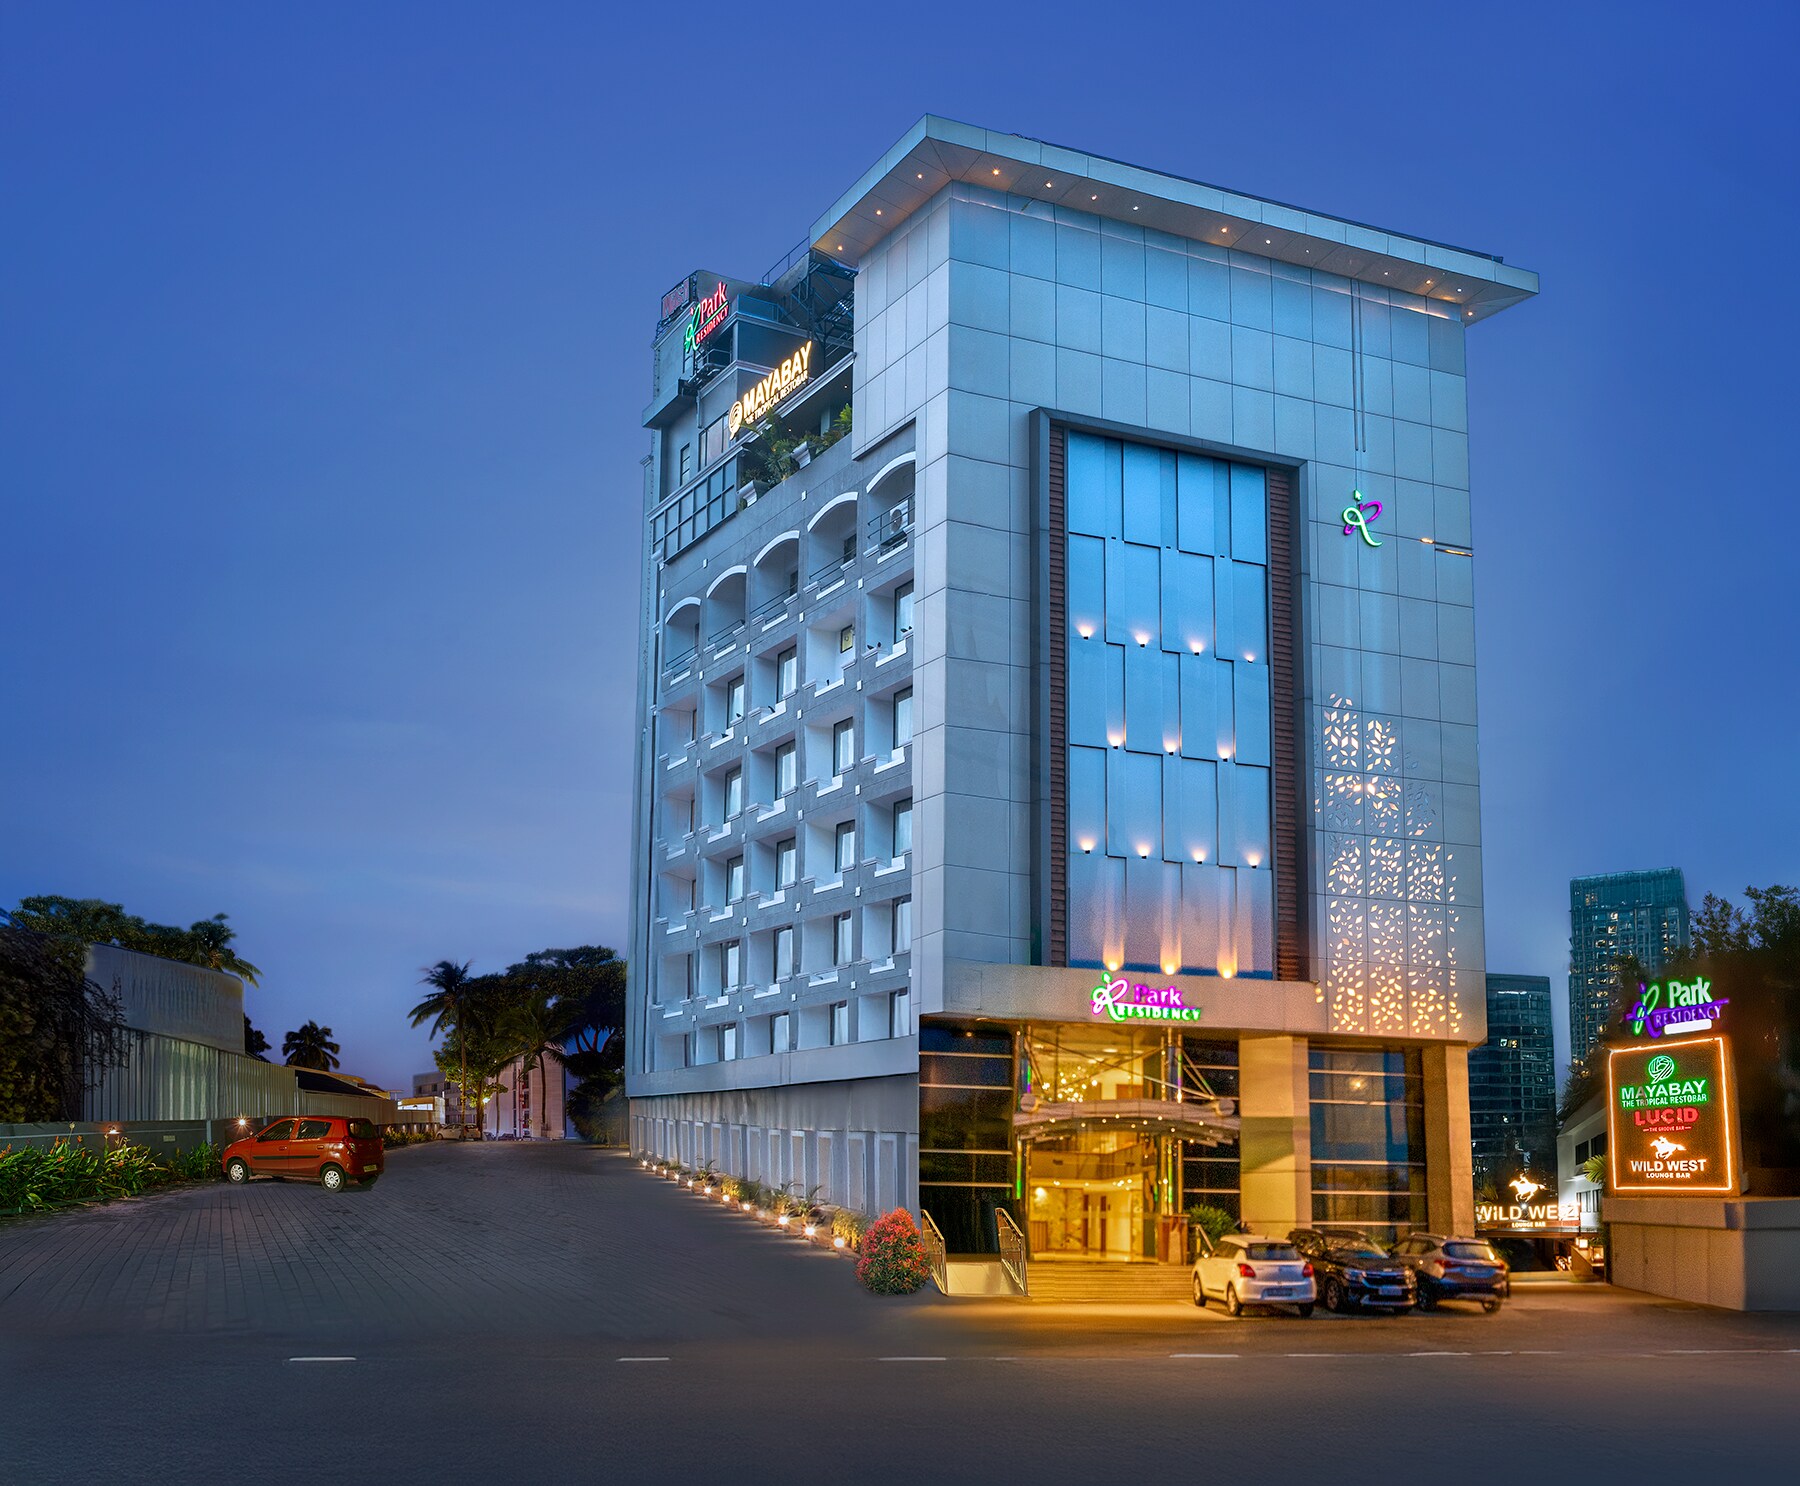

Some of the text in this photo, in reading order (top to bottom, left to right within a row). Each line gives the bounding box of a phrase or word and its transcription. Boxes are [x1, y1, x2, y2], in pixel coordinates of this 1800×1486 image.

[701, 281, 728, 325] Park
[696, 305, 729, 345] RESIDENCY
[743, 340, 812, 420] MAYABAY
[1134, 984, 1182, 1006] Park
[1667, 976, 1713, 1009] Park
[1116, 1005, 1200, 1021] RESIDENCY
[1654, 1005, 1721, 1027] RESIDENCY
[1621, 1079, 1707, 1100] MAYABAY
[1621, 1093, 1708, 1108] THE TROPICAL RESTOBAR
[1634, 1106, 1699, 1126] LUCID
[1630, 1159, 1707, 1172] WILD WEST
